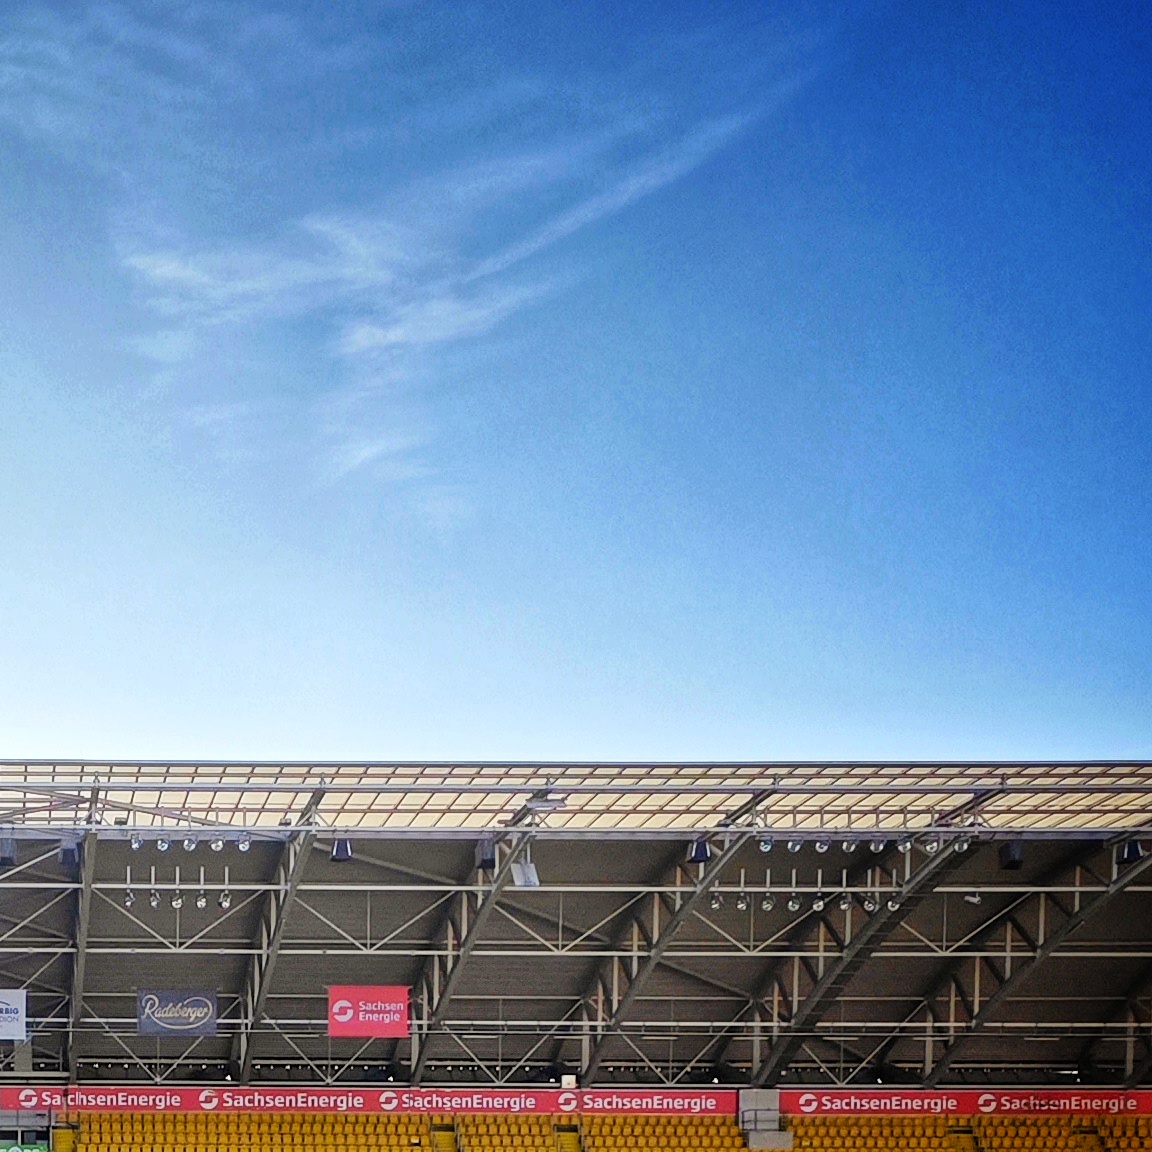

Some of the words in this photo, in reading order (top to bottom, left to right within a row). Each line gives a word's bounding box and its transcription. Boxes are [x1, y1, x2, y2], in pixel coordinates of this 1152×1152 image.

[141, 994, 212, 1030] Radeberger
[358, 1000, 404, 1012] Sachsen
[358, 1011, 401, 1023] Energie
[41, 1092, 181, 1110] SachsenEnergie
[222, 1092, 364, 1110] SachsenEnergie
[401, 1093, 536, 1111] SachsenEnergie
[583, 1094, 717, 1112] SachsenEnergie
[821, 1096, 957, 1112] SachsenEnergie
